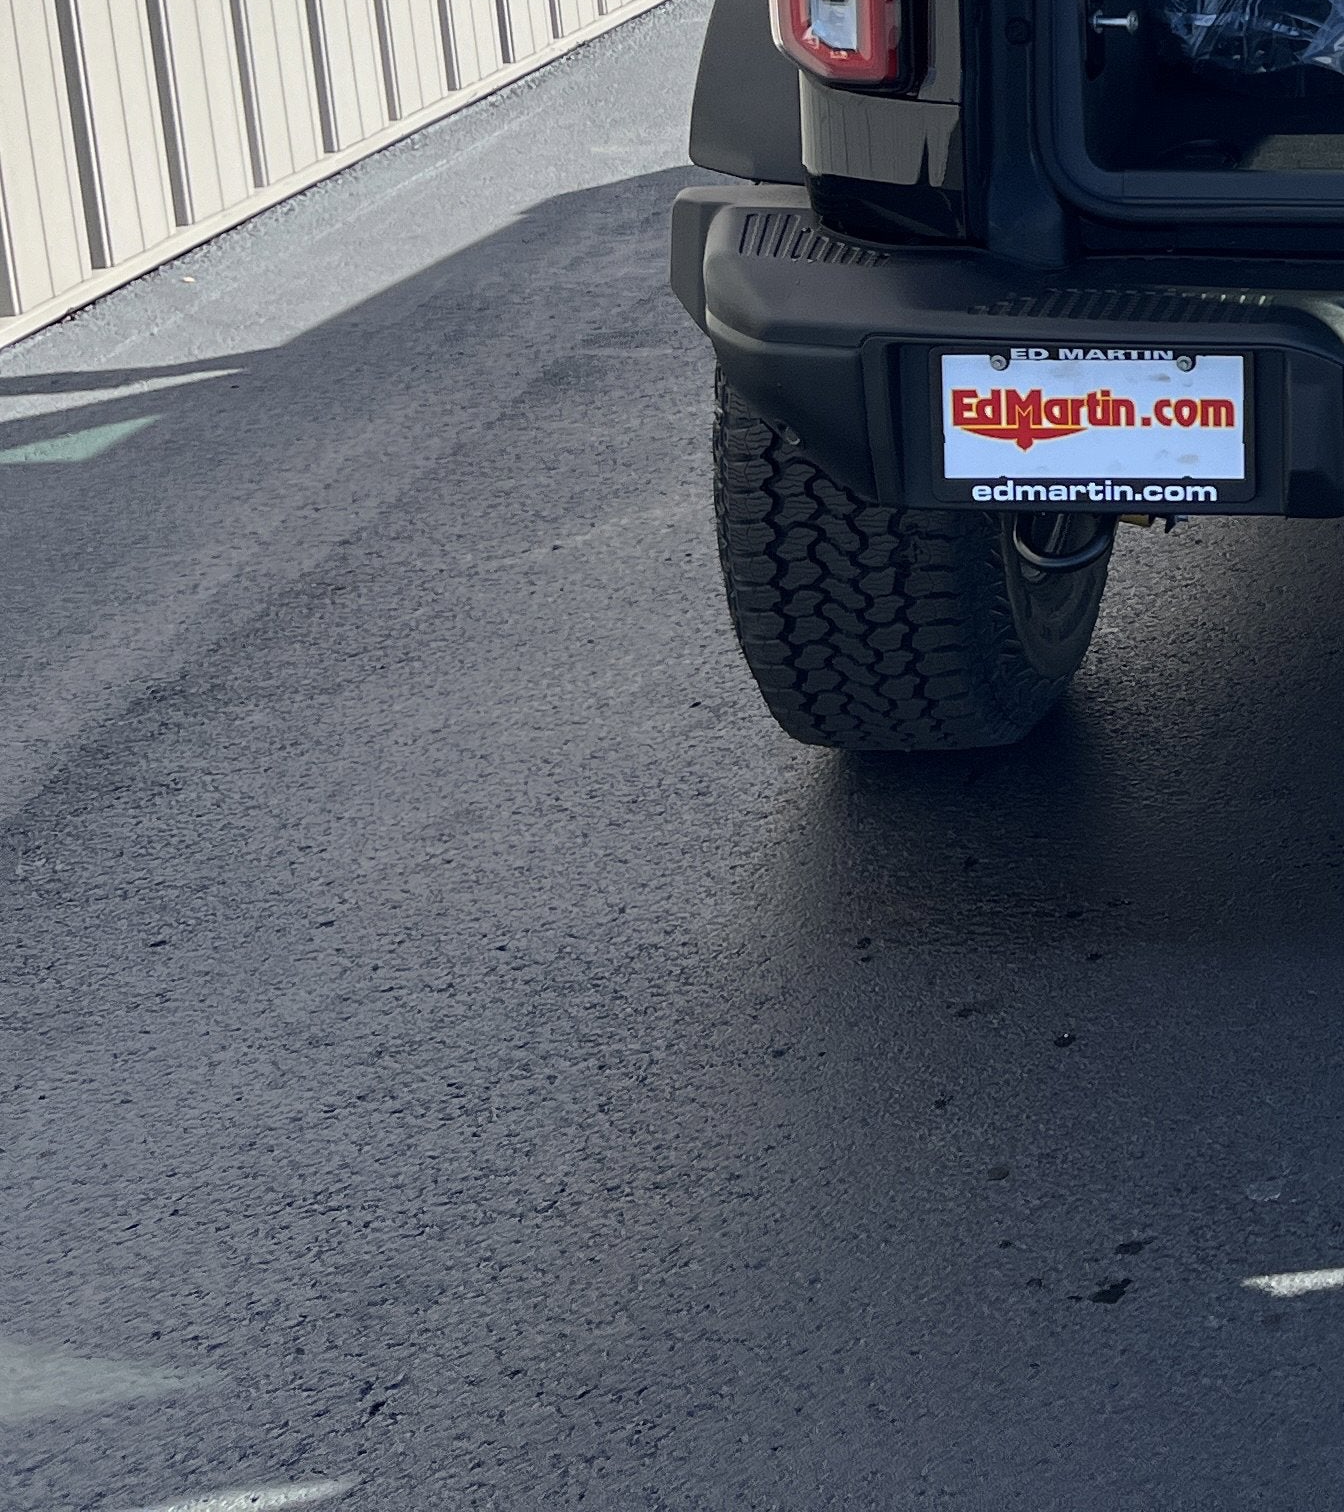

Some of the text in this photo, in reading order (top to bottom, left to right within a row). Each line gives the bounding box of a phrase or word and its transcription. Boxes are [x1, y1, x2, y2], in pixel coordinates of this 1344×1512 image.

[1010, 348, 1174, 360] ED MARTIN
[971, 480, 1218, 501] edmartin.com
